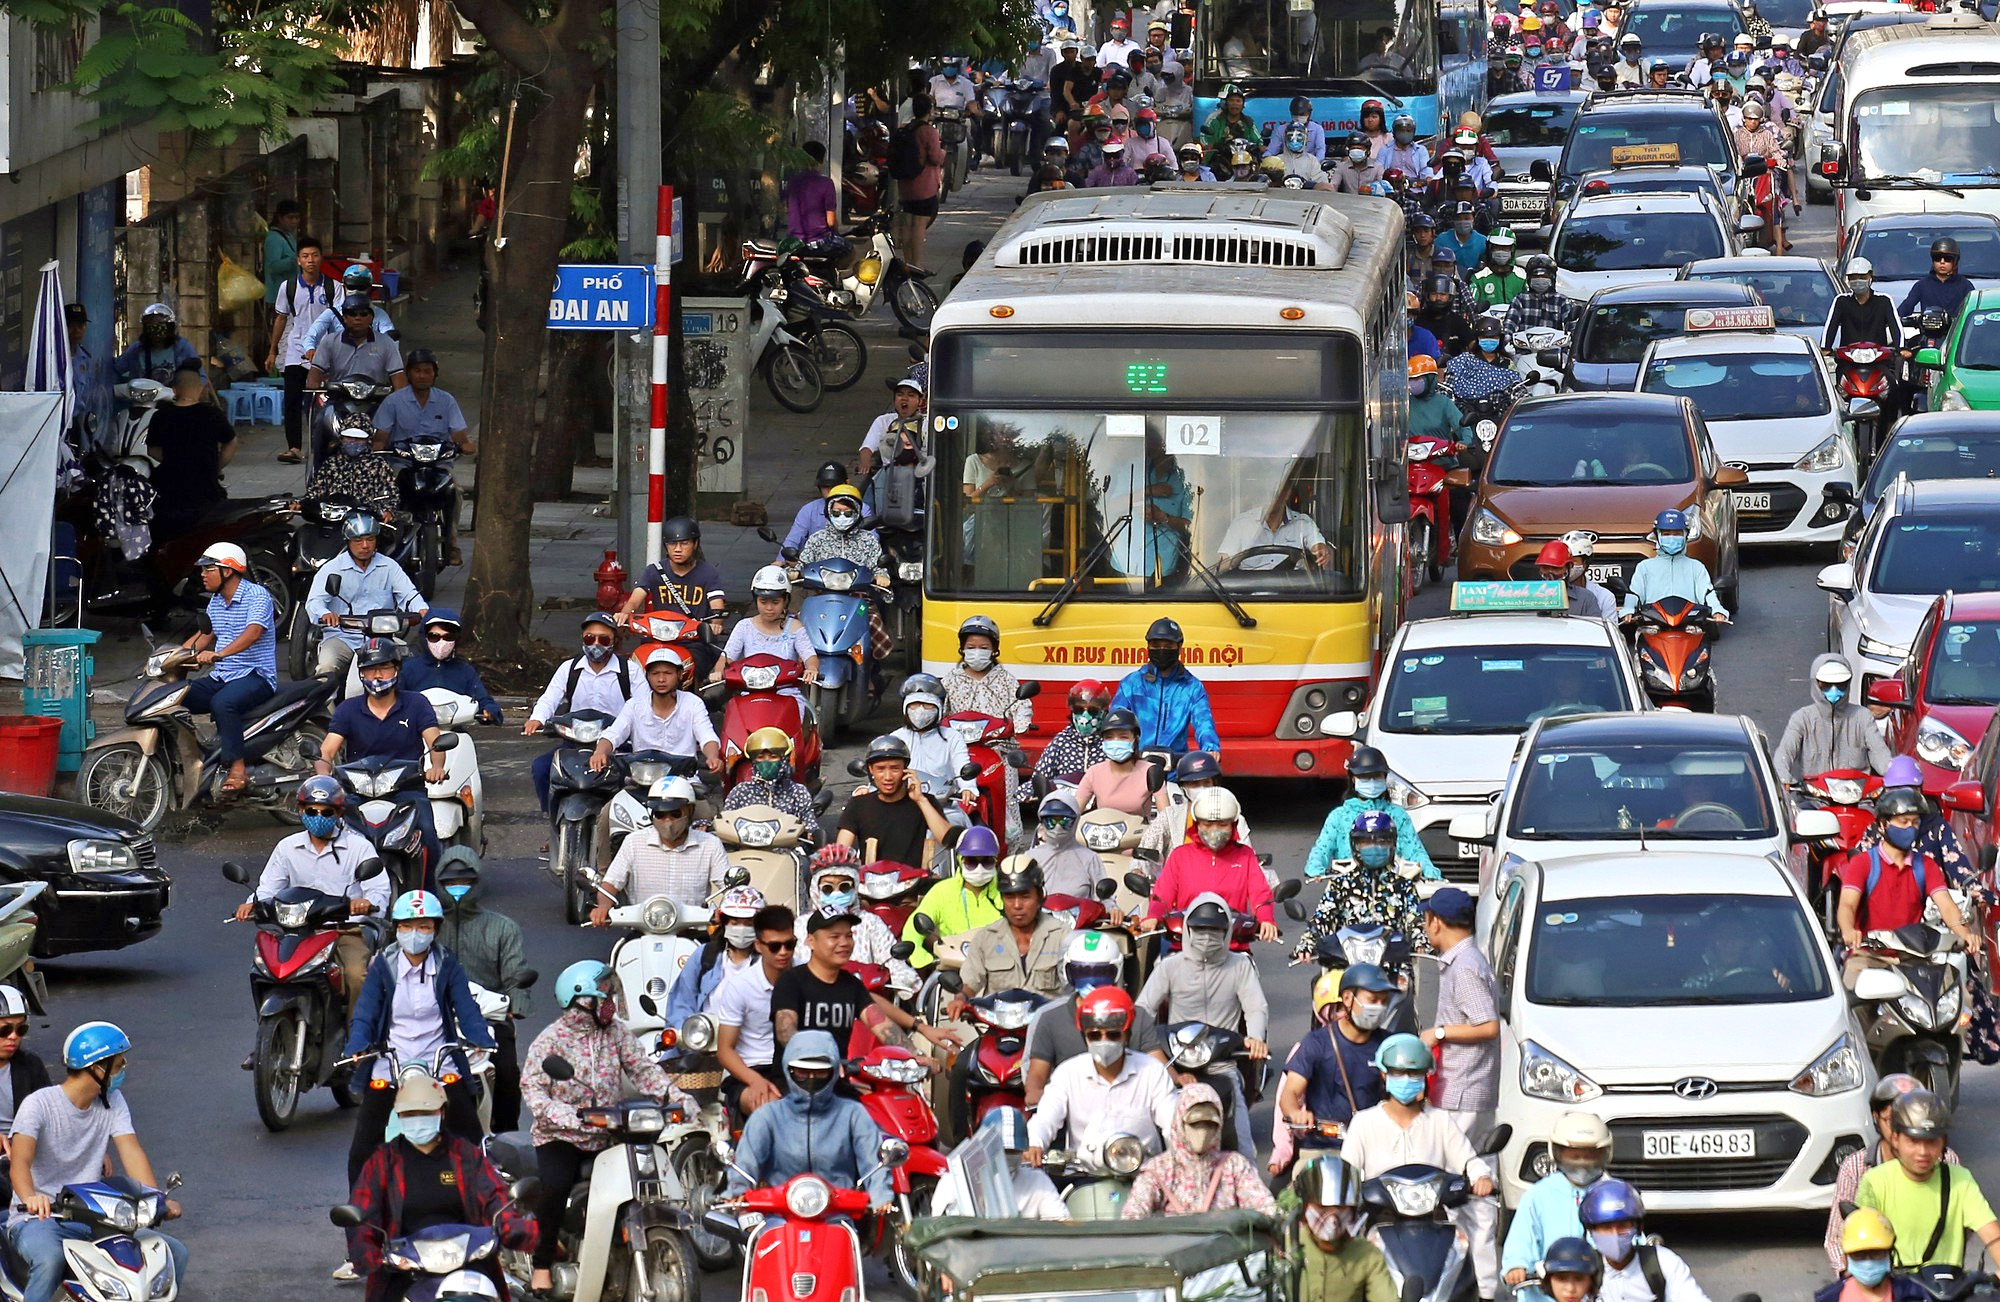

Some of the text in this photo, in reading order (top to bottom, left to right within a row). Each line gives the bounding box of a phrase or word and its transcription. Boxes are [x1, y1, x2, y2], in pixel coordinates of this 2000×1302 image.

[1543, 70, 1562, 88] G7
[583, 272, 623, 290] PHỐ
[595, 299, 628, 321] AN
[1127, 365, 1167, 392] 02
[1180, 423, 1209, 446] 02
[1461, 587, 1487, 595] TAXI
[1488, 584, 1529, 598] Thành
[1073, 646, 1106, 663] BUS
[1111, 647, 1148, 664] NHA
[1209, 644, 1243, 667] NỘI
[804, 1002, 855, 1028] ICON
[1647, 1133, 1751, 1155] 30E-469.83
